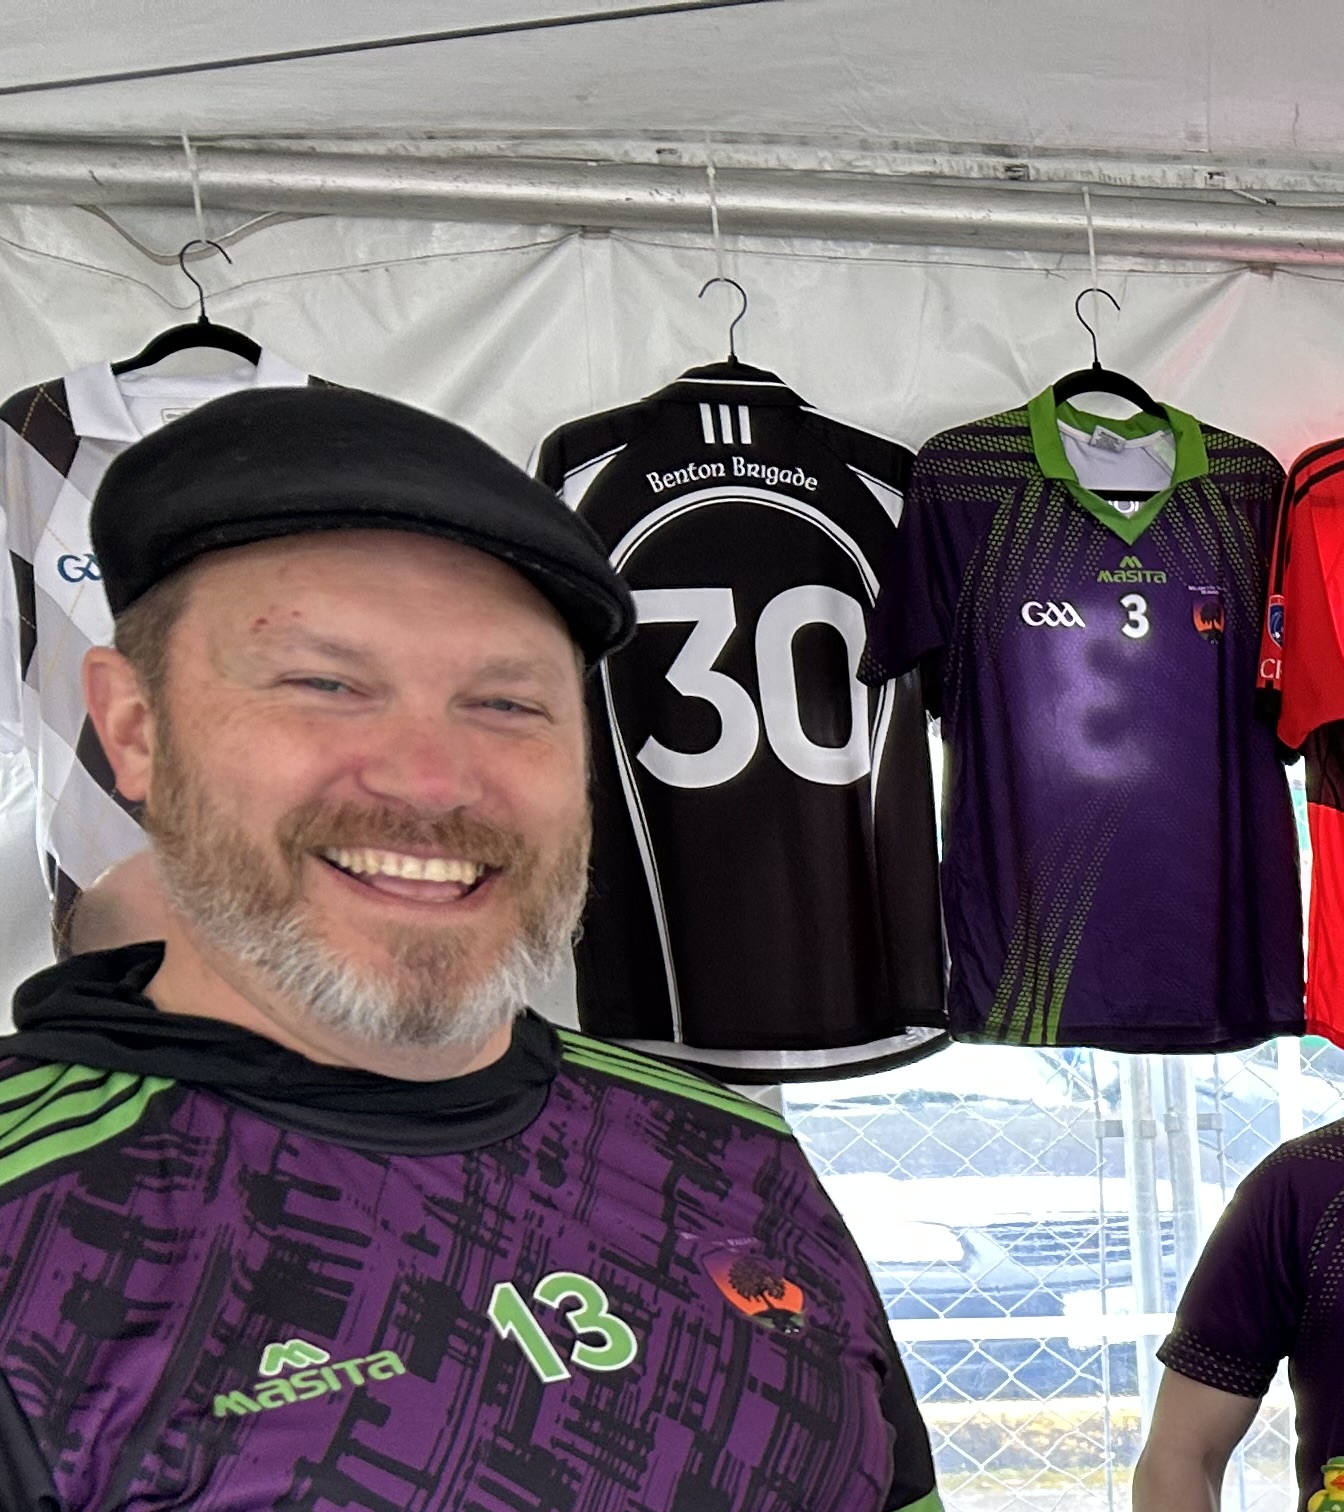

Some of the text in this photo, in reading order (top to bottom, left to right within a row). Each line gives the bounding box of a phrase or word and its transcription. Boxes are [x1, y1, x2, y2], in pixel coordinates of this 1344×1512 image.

[645, 456, 819, 494] Benton Brigade
[1120, 593, 1150, 639] 3
[630, 584, 873, 790] 30
[488, 1271, 638, 1383] 13
